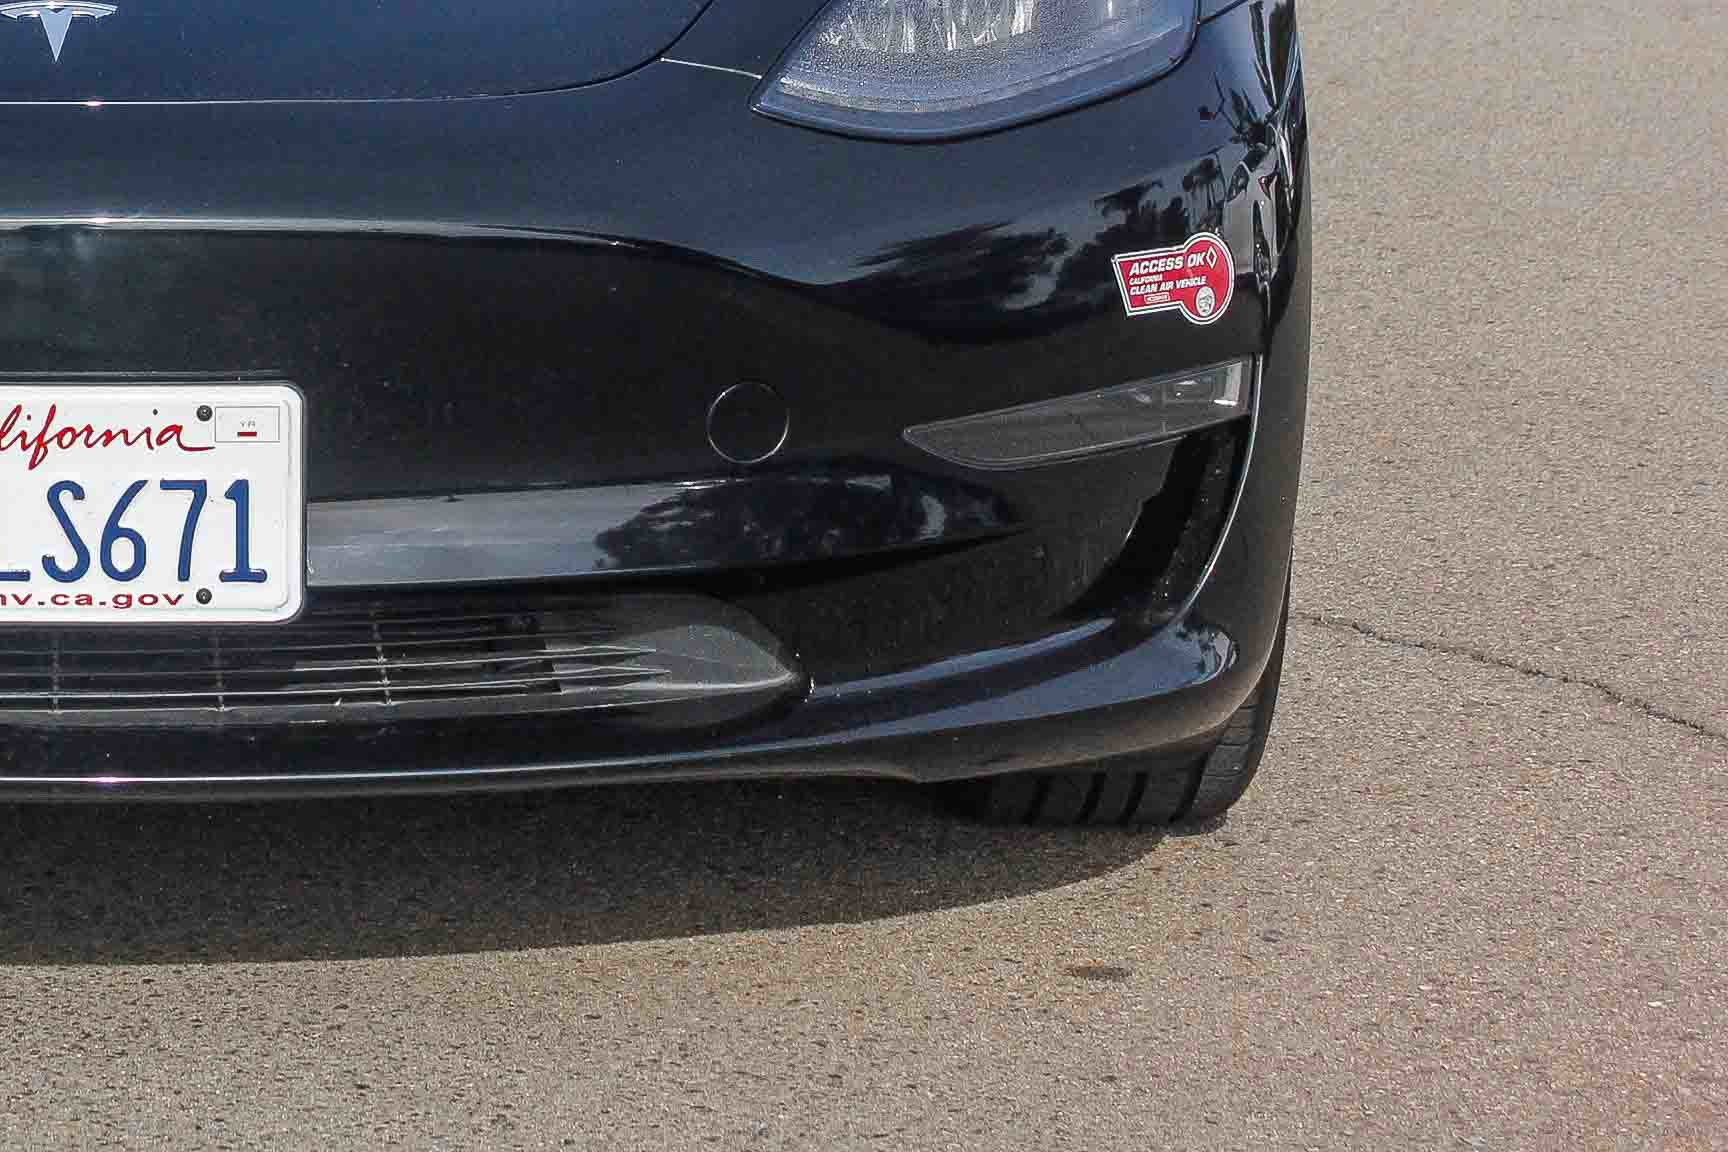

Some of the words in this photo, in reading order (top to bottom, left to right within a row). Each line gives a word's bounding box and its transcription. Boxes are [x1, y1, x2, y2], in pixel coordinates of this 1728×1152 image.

[1129, 256, 1184, 276] ACCESS
[1187, 251, 1206, 268] OK
[1129, 284, 1158, 296] CLEAN
[1159, 281, 1174, 292] AIR
[1176, 276, 1207, 289] VEHICLE
